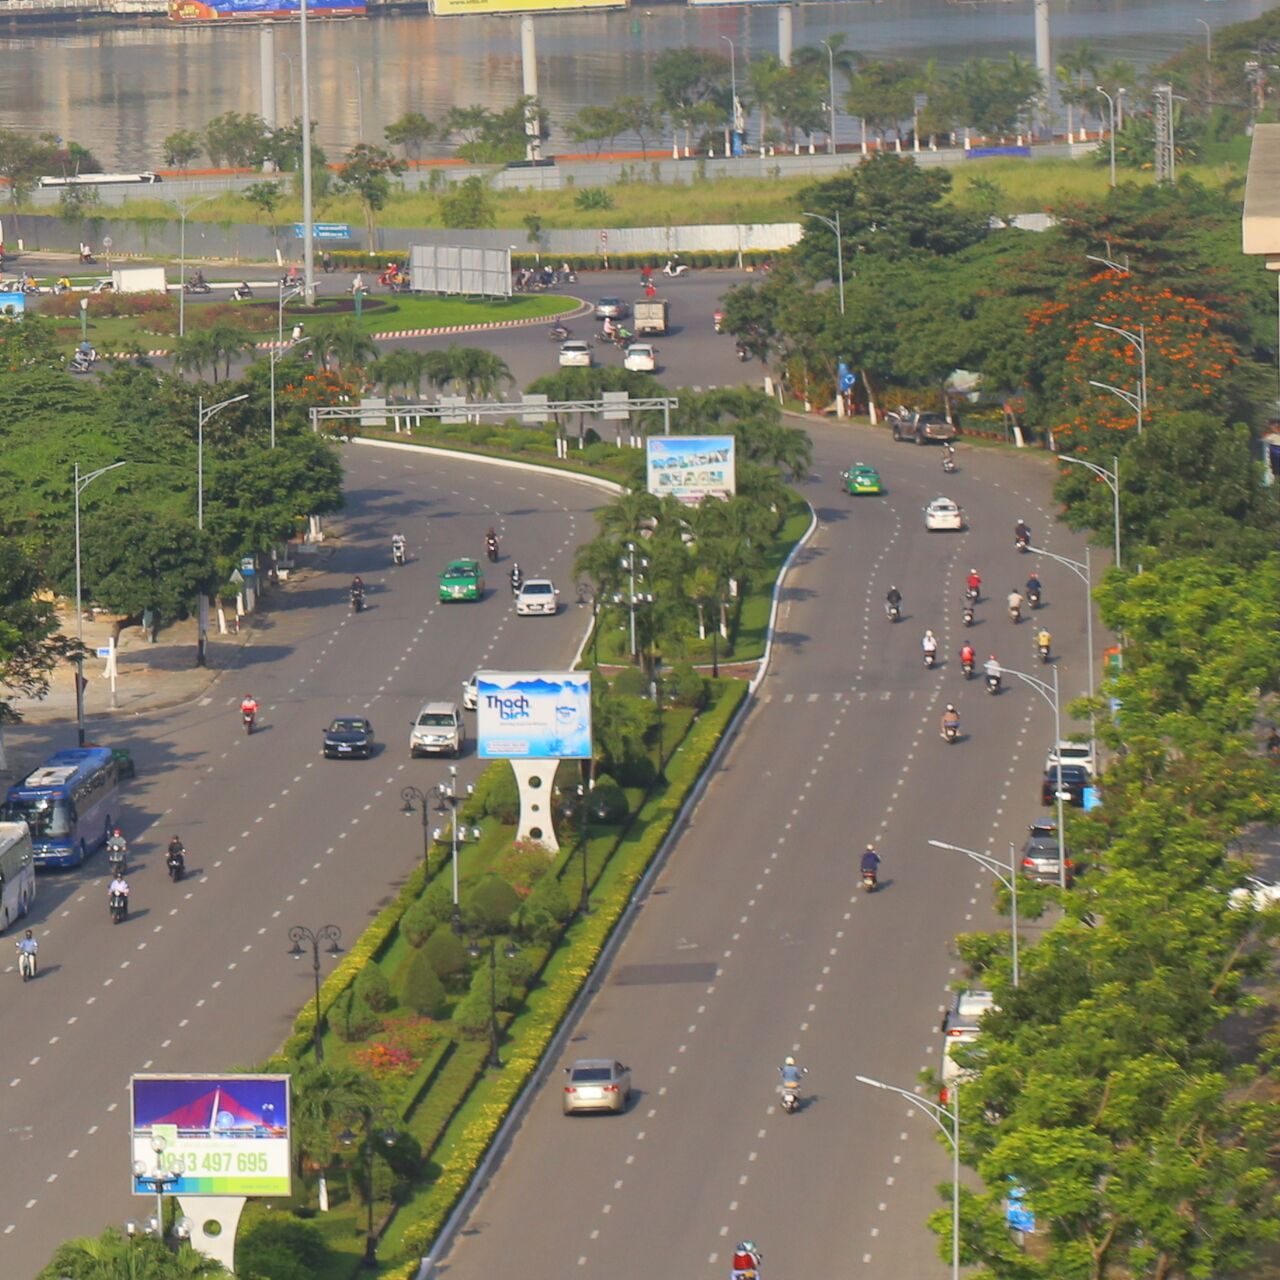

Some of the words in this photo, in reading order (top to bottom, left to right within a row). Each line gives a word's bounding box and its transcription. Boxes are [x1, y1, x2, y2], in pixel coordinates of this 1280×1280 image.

[651, 448, 730, 469] HOLIDAY
[202, 1152, 233, 1173] 497
[237, 1152, 268, 1172] 695
